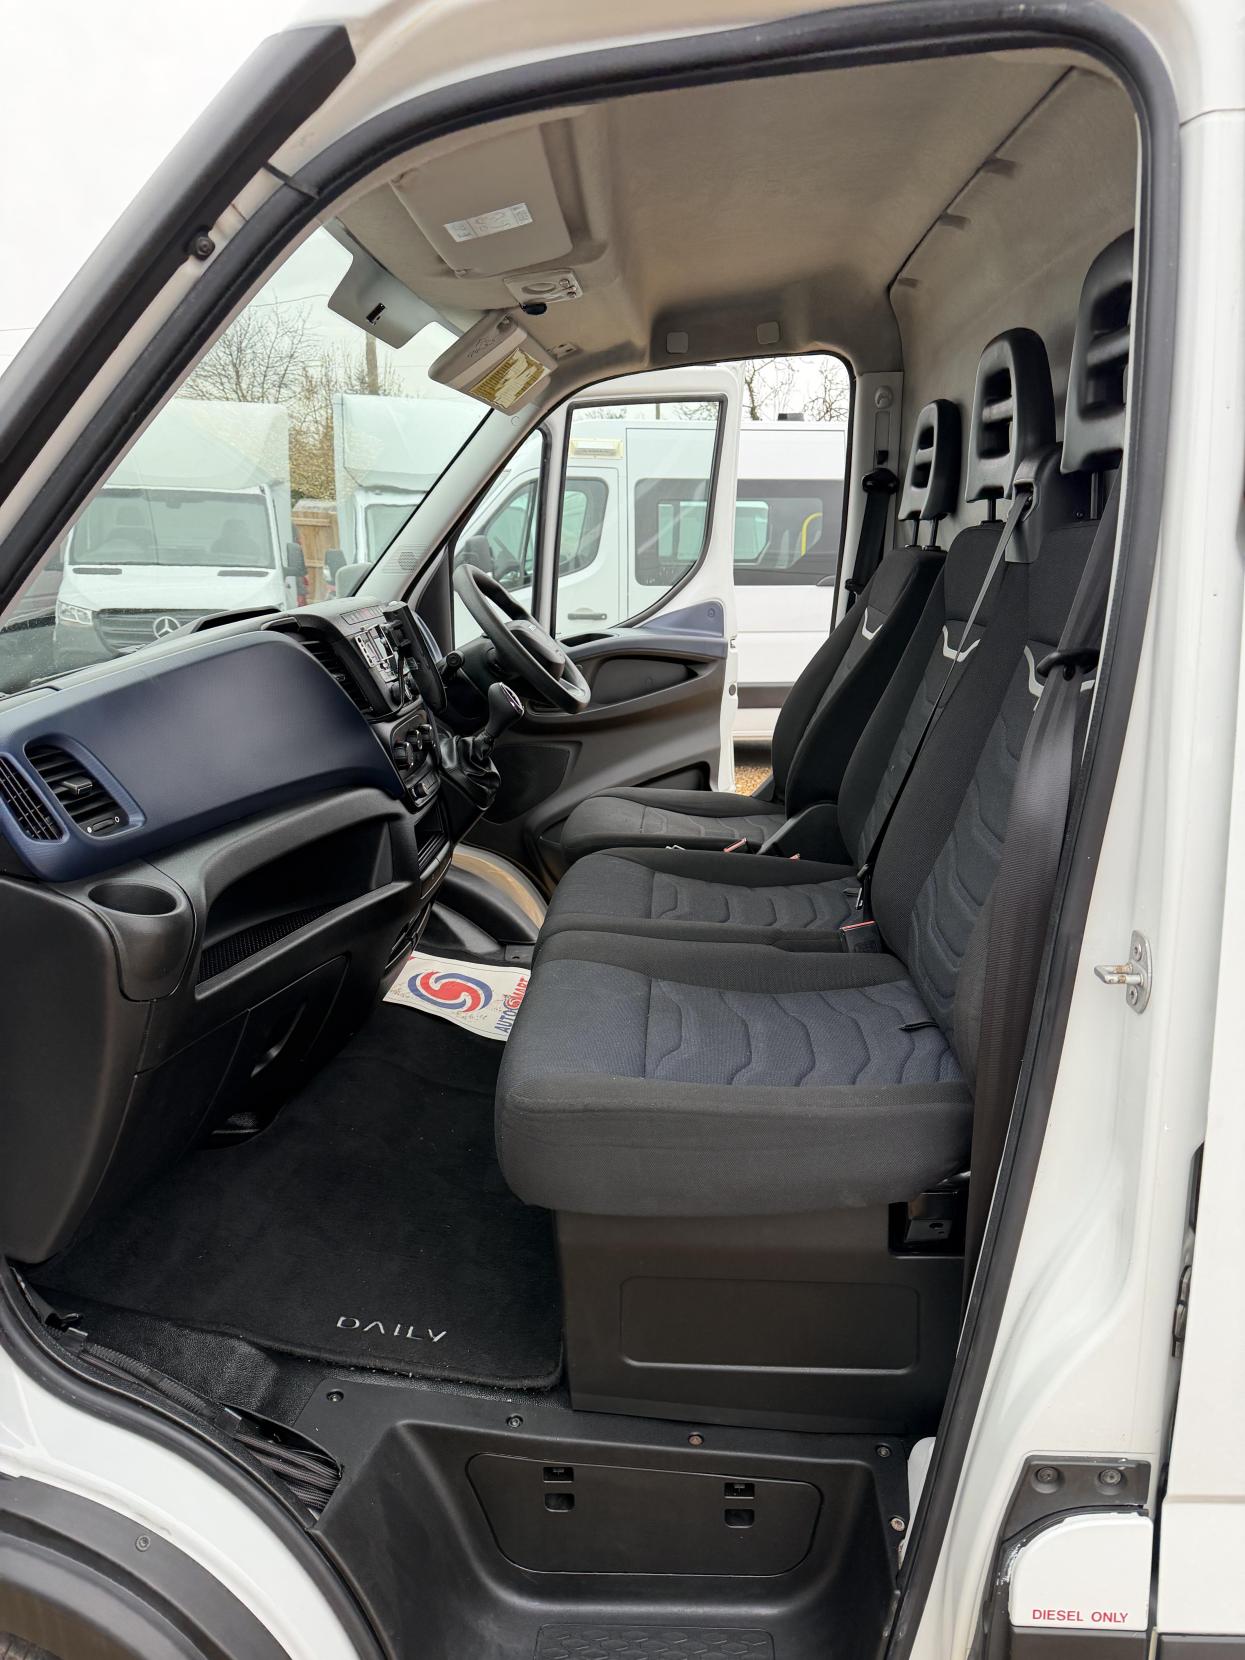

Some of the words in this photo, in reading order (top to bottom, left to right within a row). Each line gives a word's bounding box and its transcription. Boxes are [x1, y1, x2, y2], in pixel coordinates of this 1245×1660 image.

[336, 1316, 447, 1342] DAILY
[1032, 1609, 1083, 1622] DIESEL
[1091, 1611, 1129, 1623] ONLY
